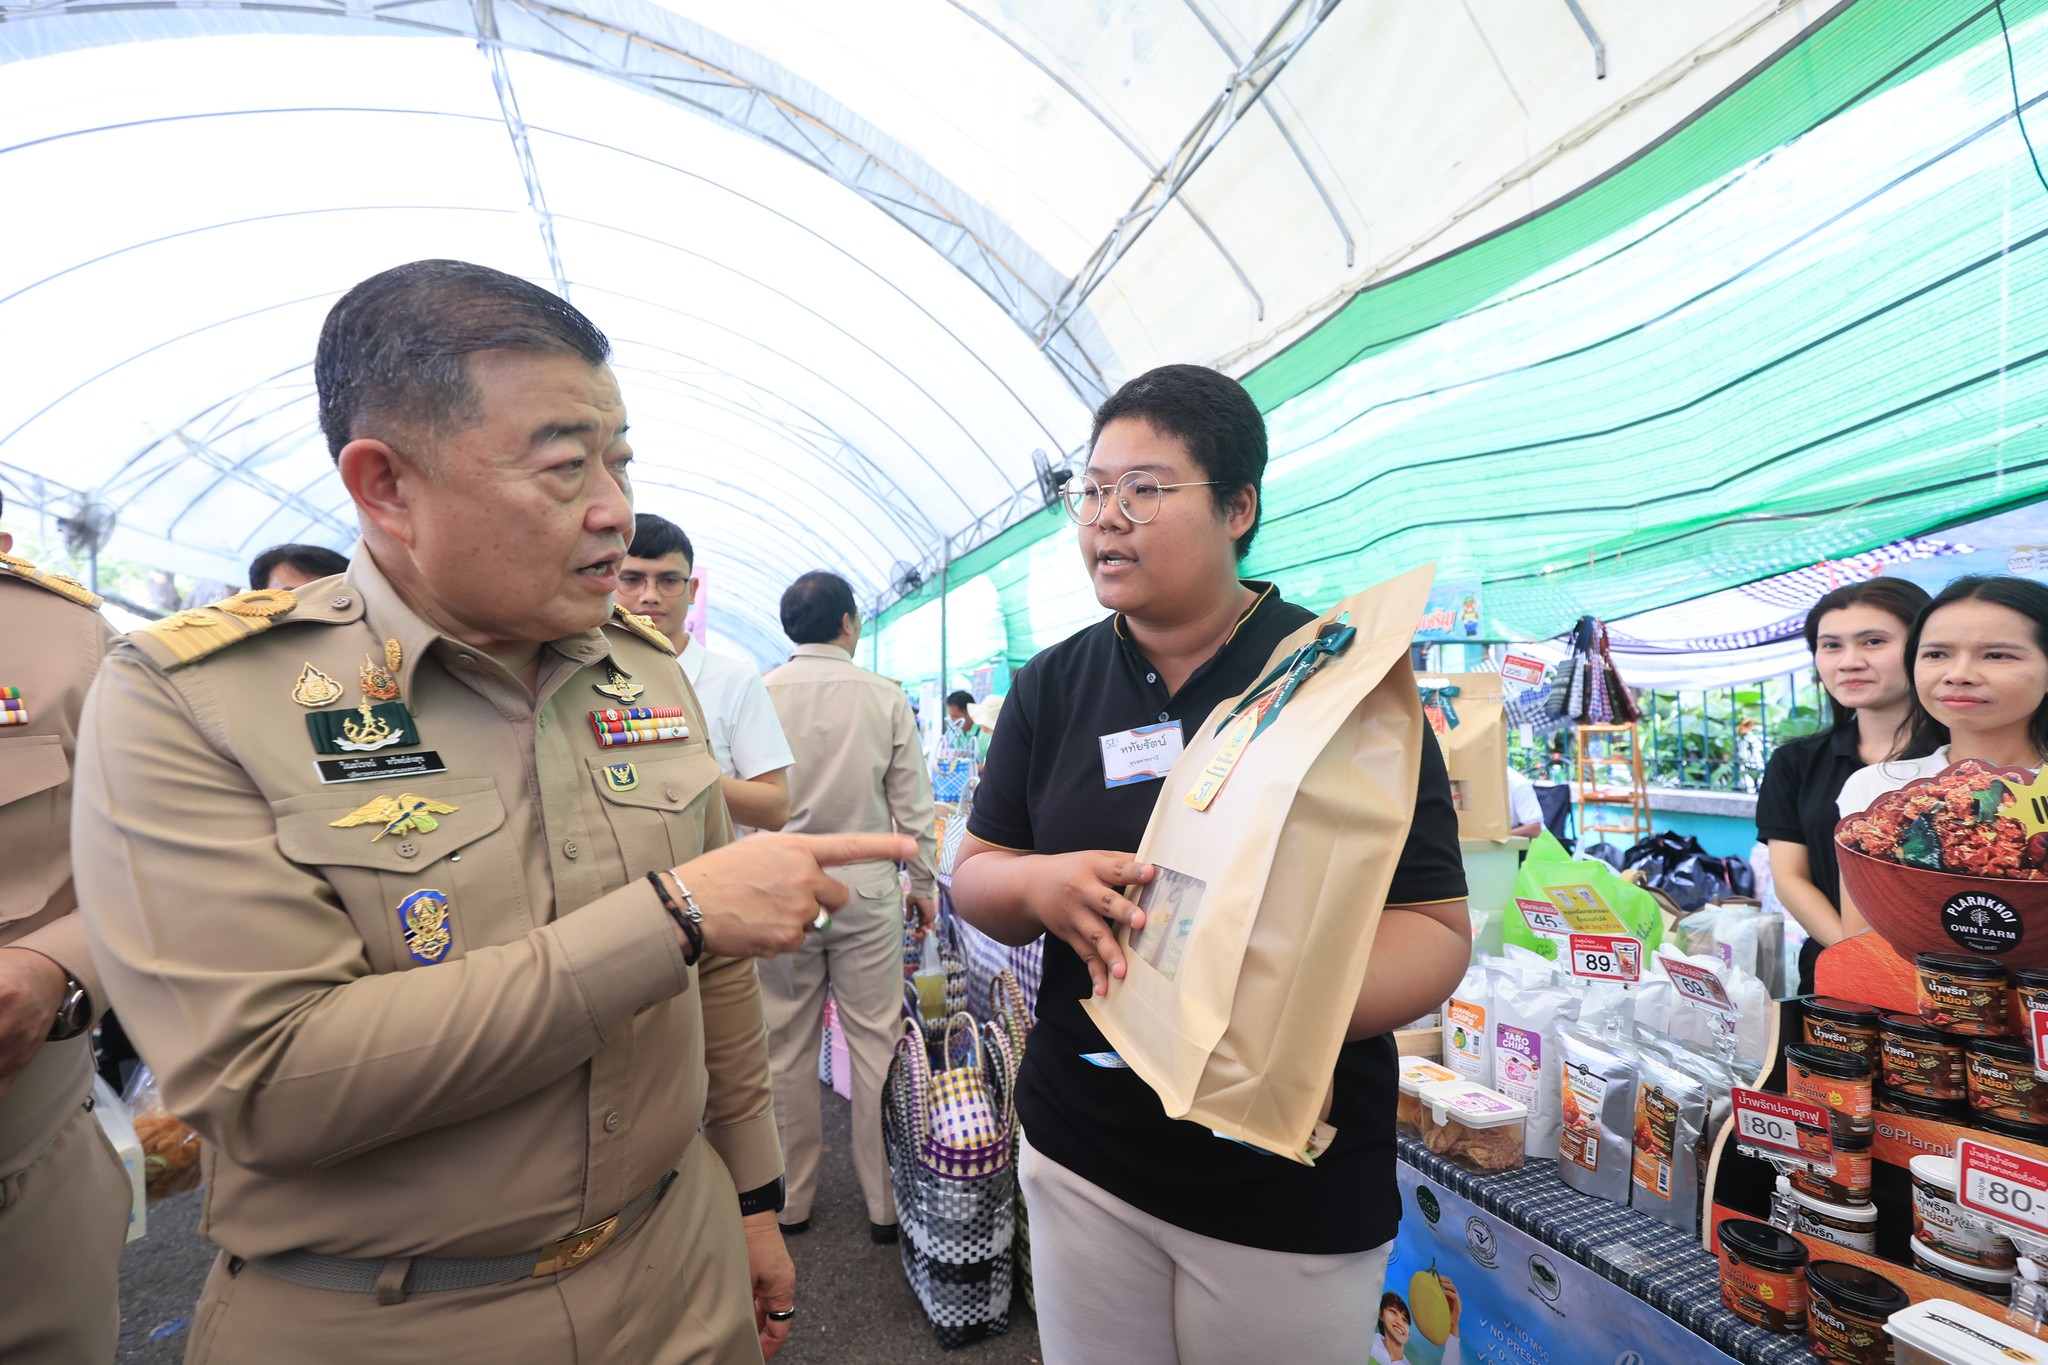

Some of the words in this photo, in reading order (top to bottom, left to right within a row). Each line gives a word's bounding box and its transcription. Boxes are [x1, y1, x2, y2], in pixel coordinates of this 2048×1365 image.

[1120, 734, 1168, 754] หทัยรัตน์
[1946, 896, 2017, 923] PLARNKHOI
[1950, 924, 1978, 935] OWN
[1982, 928, 2016, 940] FARM
[1929, 979, 1968, 996] น้ำพริก
[1502, 1039, 1531, 1055] CHIPS
[1504, 1031, 1530, 1047] TARO
[1972, 1060, 2009, 1080] น้ำพริก
[1738, 1091, 1820, 1125] น้ำพริกปลาดุกฟู
[1750, 1116, 1793, 1142] 80.-
[1988, 1181, 2047, 1216] 80.-
[1490, 1323, 1504, 1341] NO
[1513, 1325, 1529, 1343] NO
